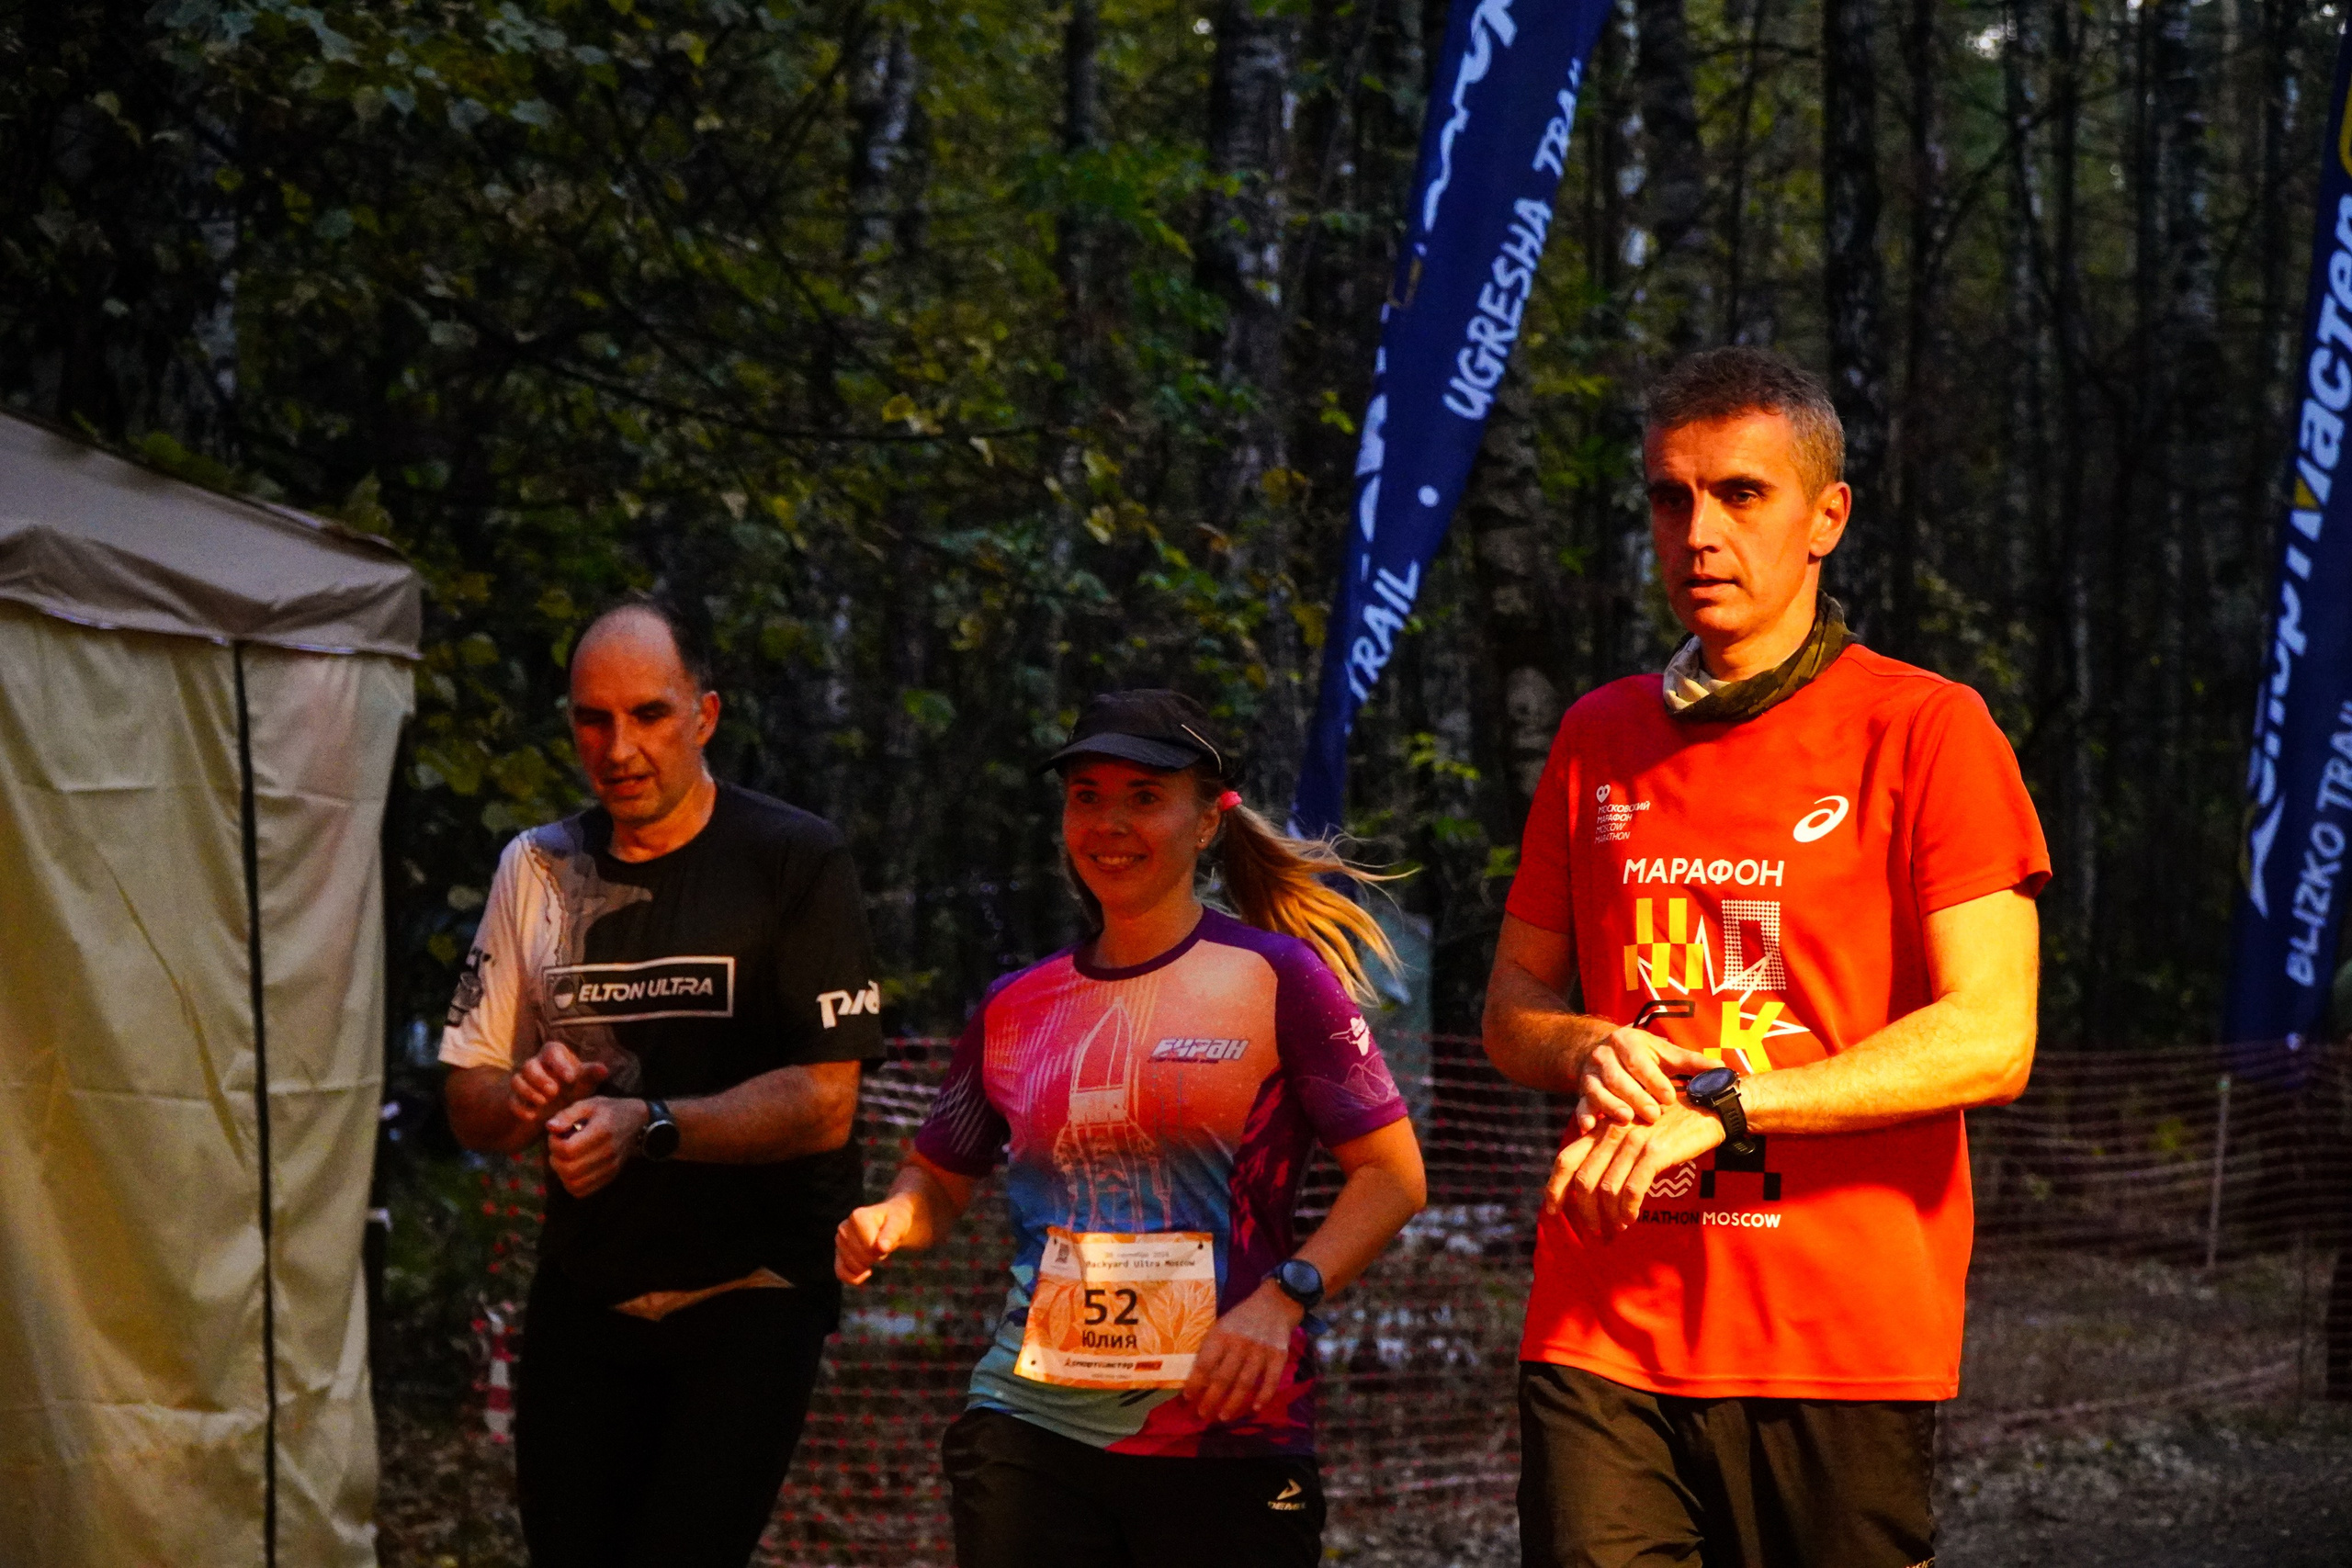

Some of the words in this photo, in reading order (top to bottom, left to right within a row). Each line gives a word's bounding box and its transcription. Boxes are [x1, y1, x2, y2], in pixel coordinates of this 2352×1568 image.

[1442, 197, 1555, 421] UGRESHA
[1598, 800, 1651, 815] МОСКОВСКИЙ
[1595, 822, 1627, 835] MOSCOW
[1597, 813, 1634, 825] МАРАФОН
[1594, 831, 1632, 845] MARATHON
[1623, 857, 1785, 887] МАРАФОН
[2286, 821, 2346, 988] BLIZKO
[577, 981, 646, 1003] ELTON
[647, 976, 714, 998] ULTRA
[1637, 1210, 1699, 1225] RATHON
[1702, 1211, 1781, 1228] MOSCOW
[1083, 1288, 1139, 1325] 52
